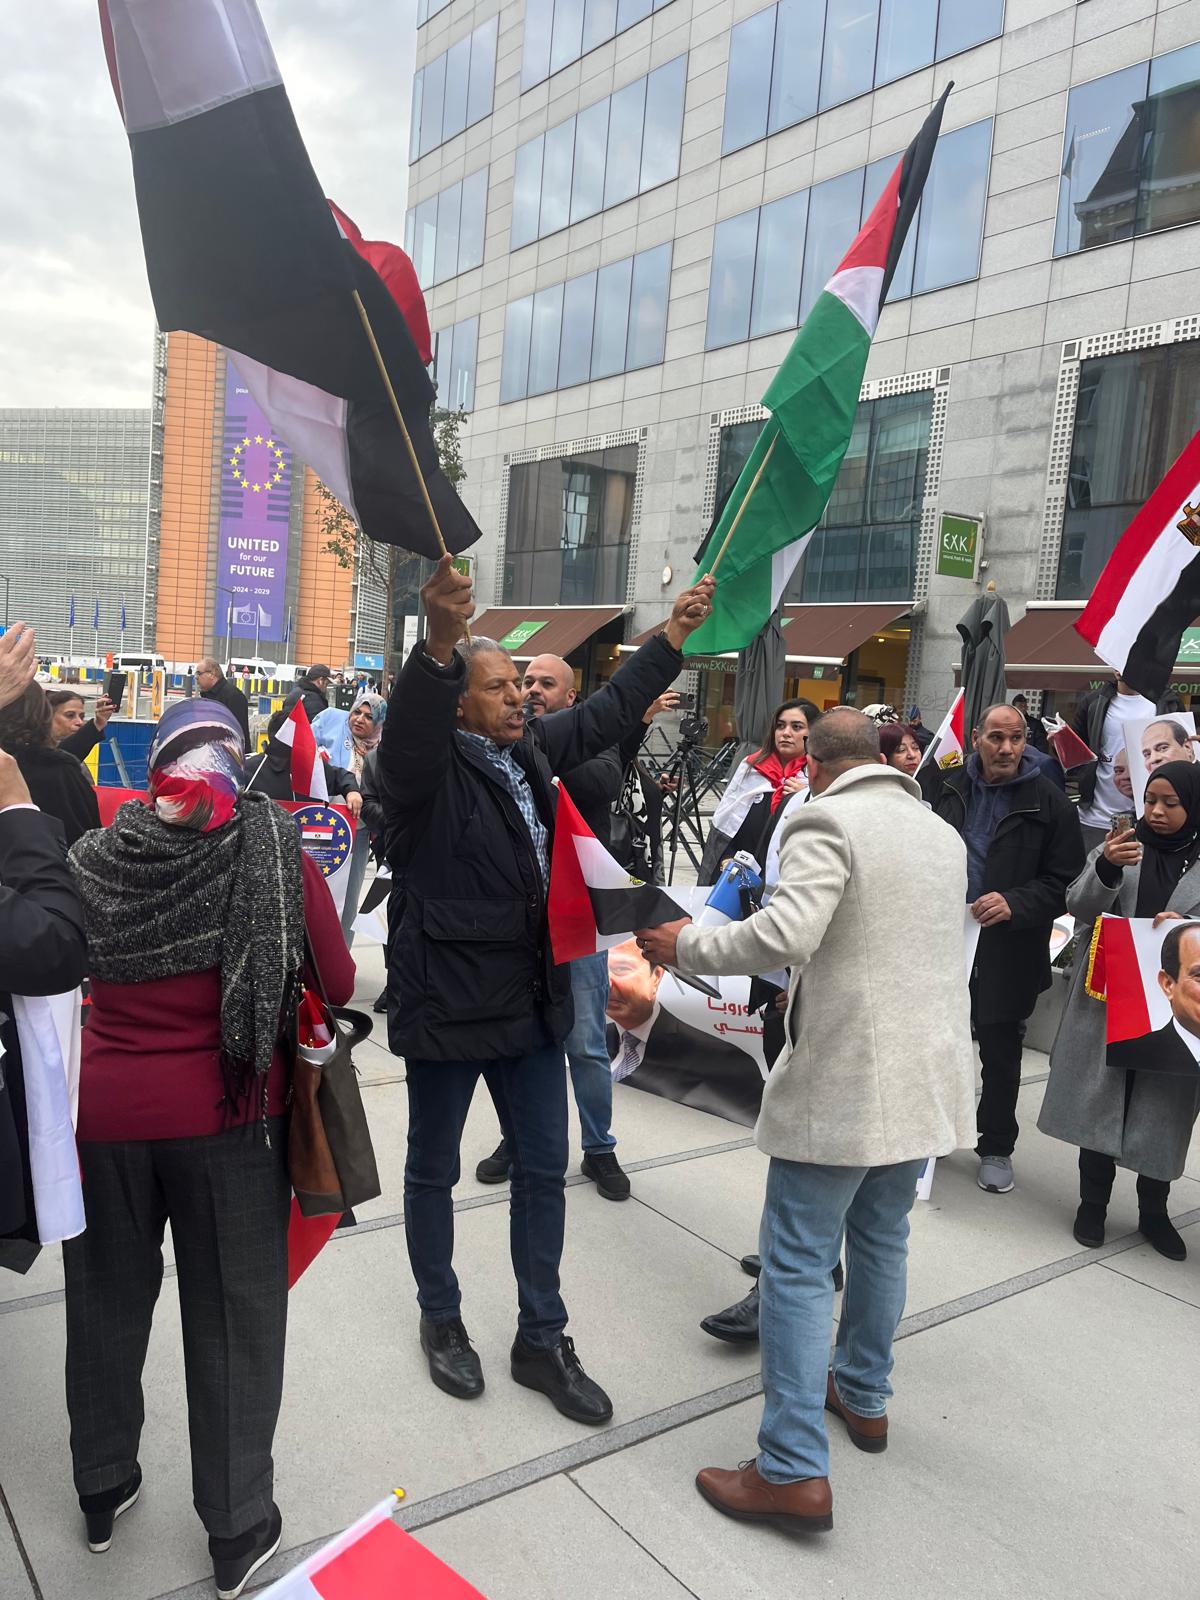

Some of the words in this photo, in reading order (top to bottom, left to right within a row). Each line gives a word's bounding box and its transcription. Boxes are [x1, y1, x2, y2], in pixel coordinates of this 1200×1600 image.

[228, 537, 280, 552] UNITED
[239, 552, 251, 561] for
[230, 565, 275, 578] FUTURE
